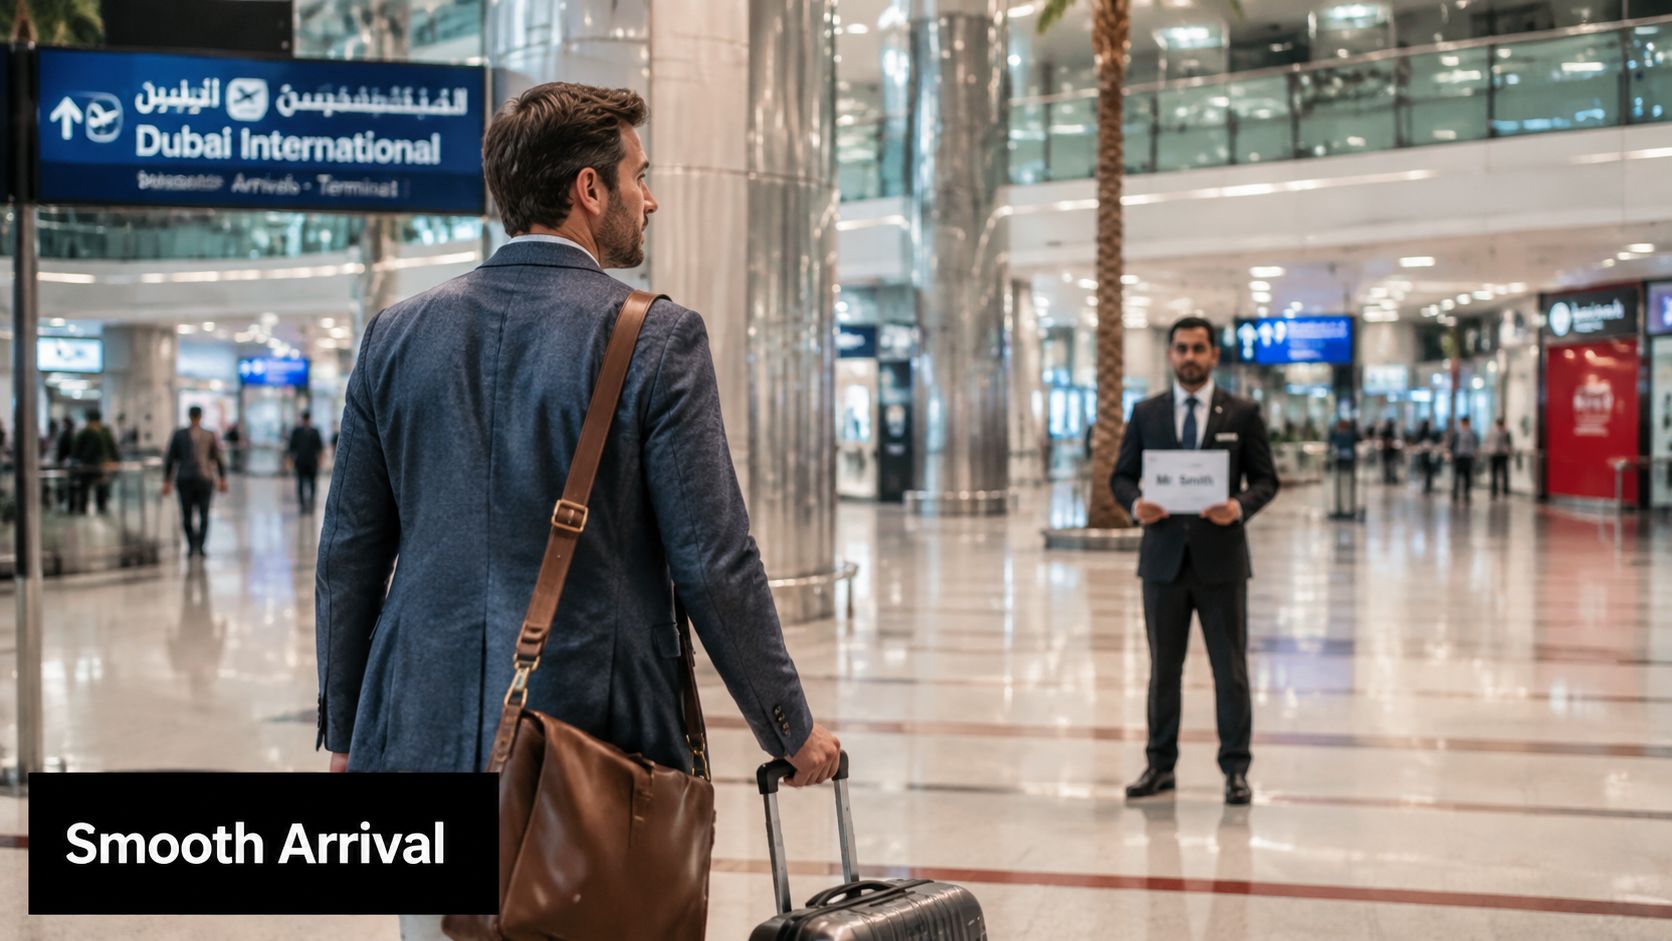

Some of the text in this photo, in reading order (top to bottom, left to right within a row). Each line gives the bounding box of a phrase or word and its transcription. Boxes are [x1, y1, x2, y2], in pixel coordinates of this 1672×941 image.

[135, 124, 441, 165] Dubai International
[1178, 474, 1214, 486] Smith
